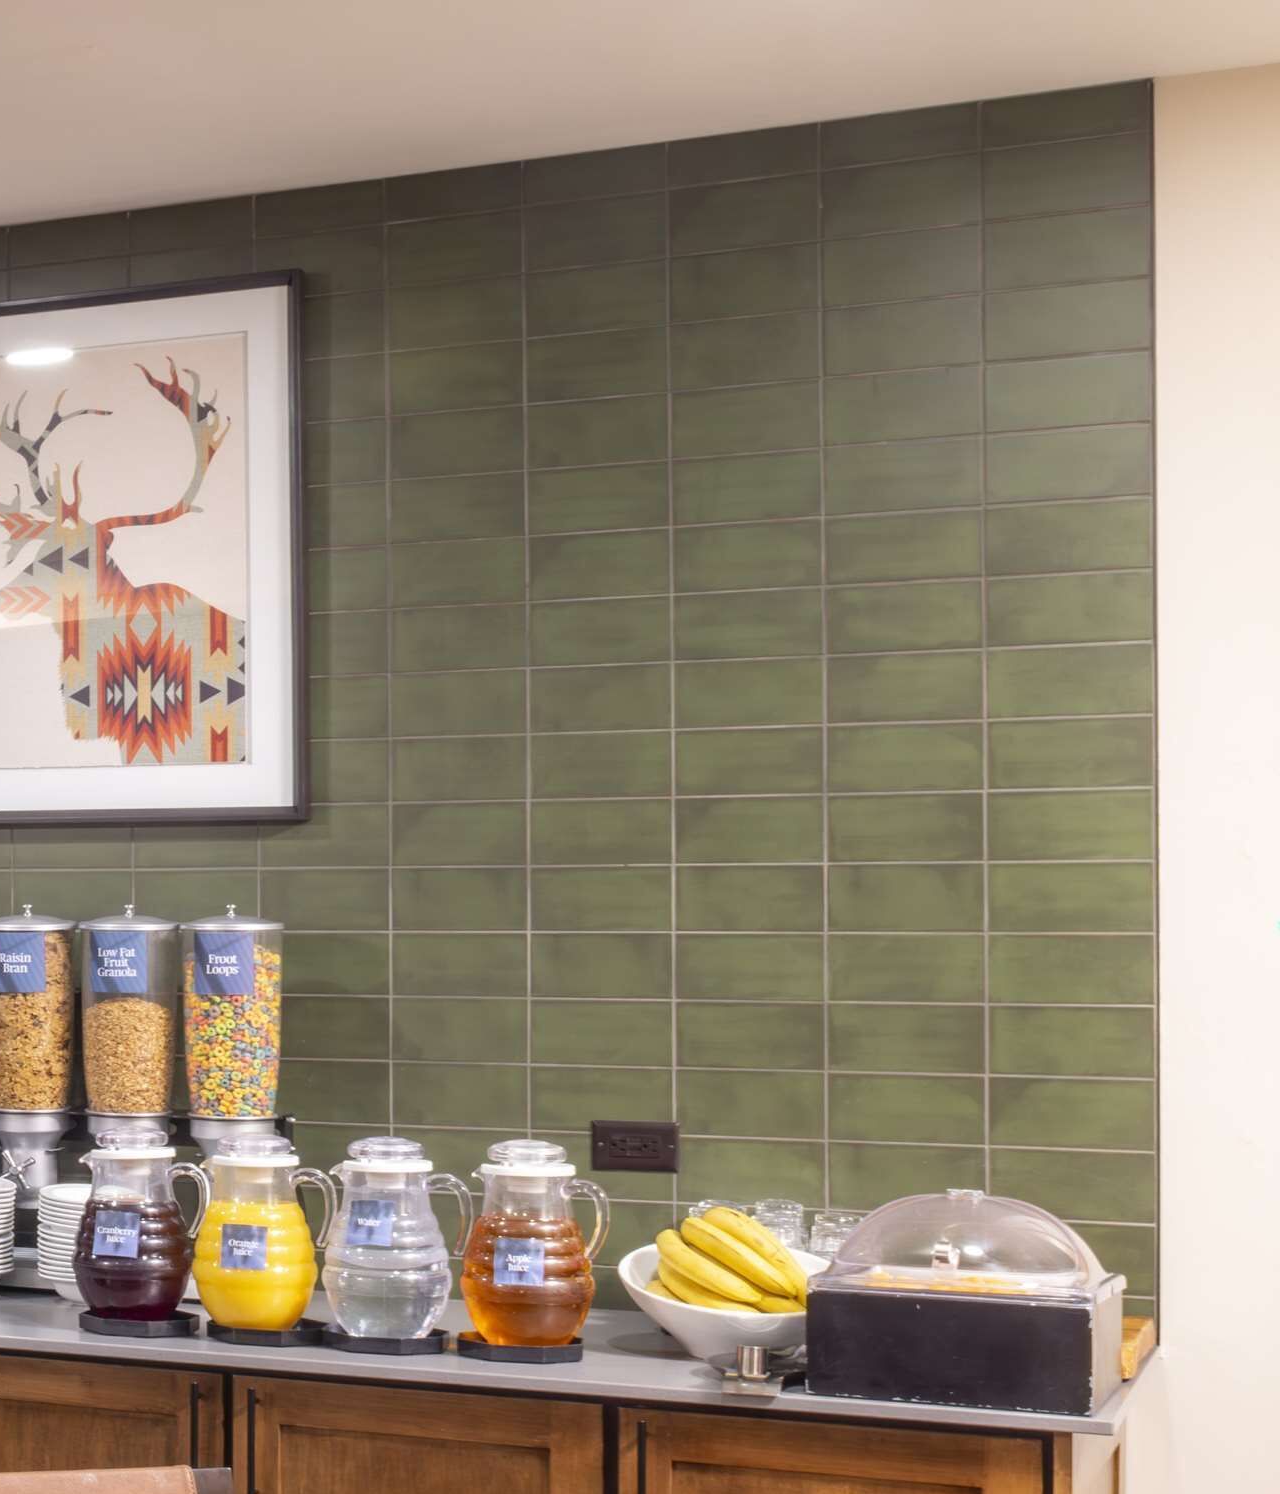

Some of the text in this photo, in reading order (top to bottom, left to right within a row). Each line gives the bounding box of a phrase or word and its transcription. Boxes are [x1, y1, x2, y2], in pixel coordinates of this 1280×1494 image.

[97, 947, 136, 957] Low Fat
[0, 953, 32, 963] Raisin
[104, 957, 129, 967] Fruit
[208, 954, 238, 964] Froot
[3, 963, 28, 973] Bran
[97, 967, 137, 977] Granola
[206, 964, 239, 976] Loops
[357, 1217, 382, 1227] Water
[97, 1226, 138, 1238] Cranberry
[105, 1234, 125, 1244] Juice
[228, 1239, 260, 1250] Orange
[233, 1248, 254, 1257] Juice
[505, 1253, 533, 1264] Apple
[507, 1262, 530, 1272] Juice
